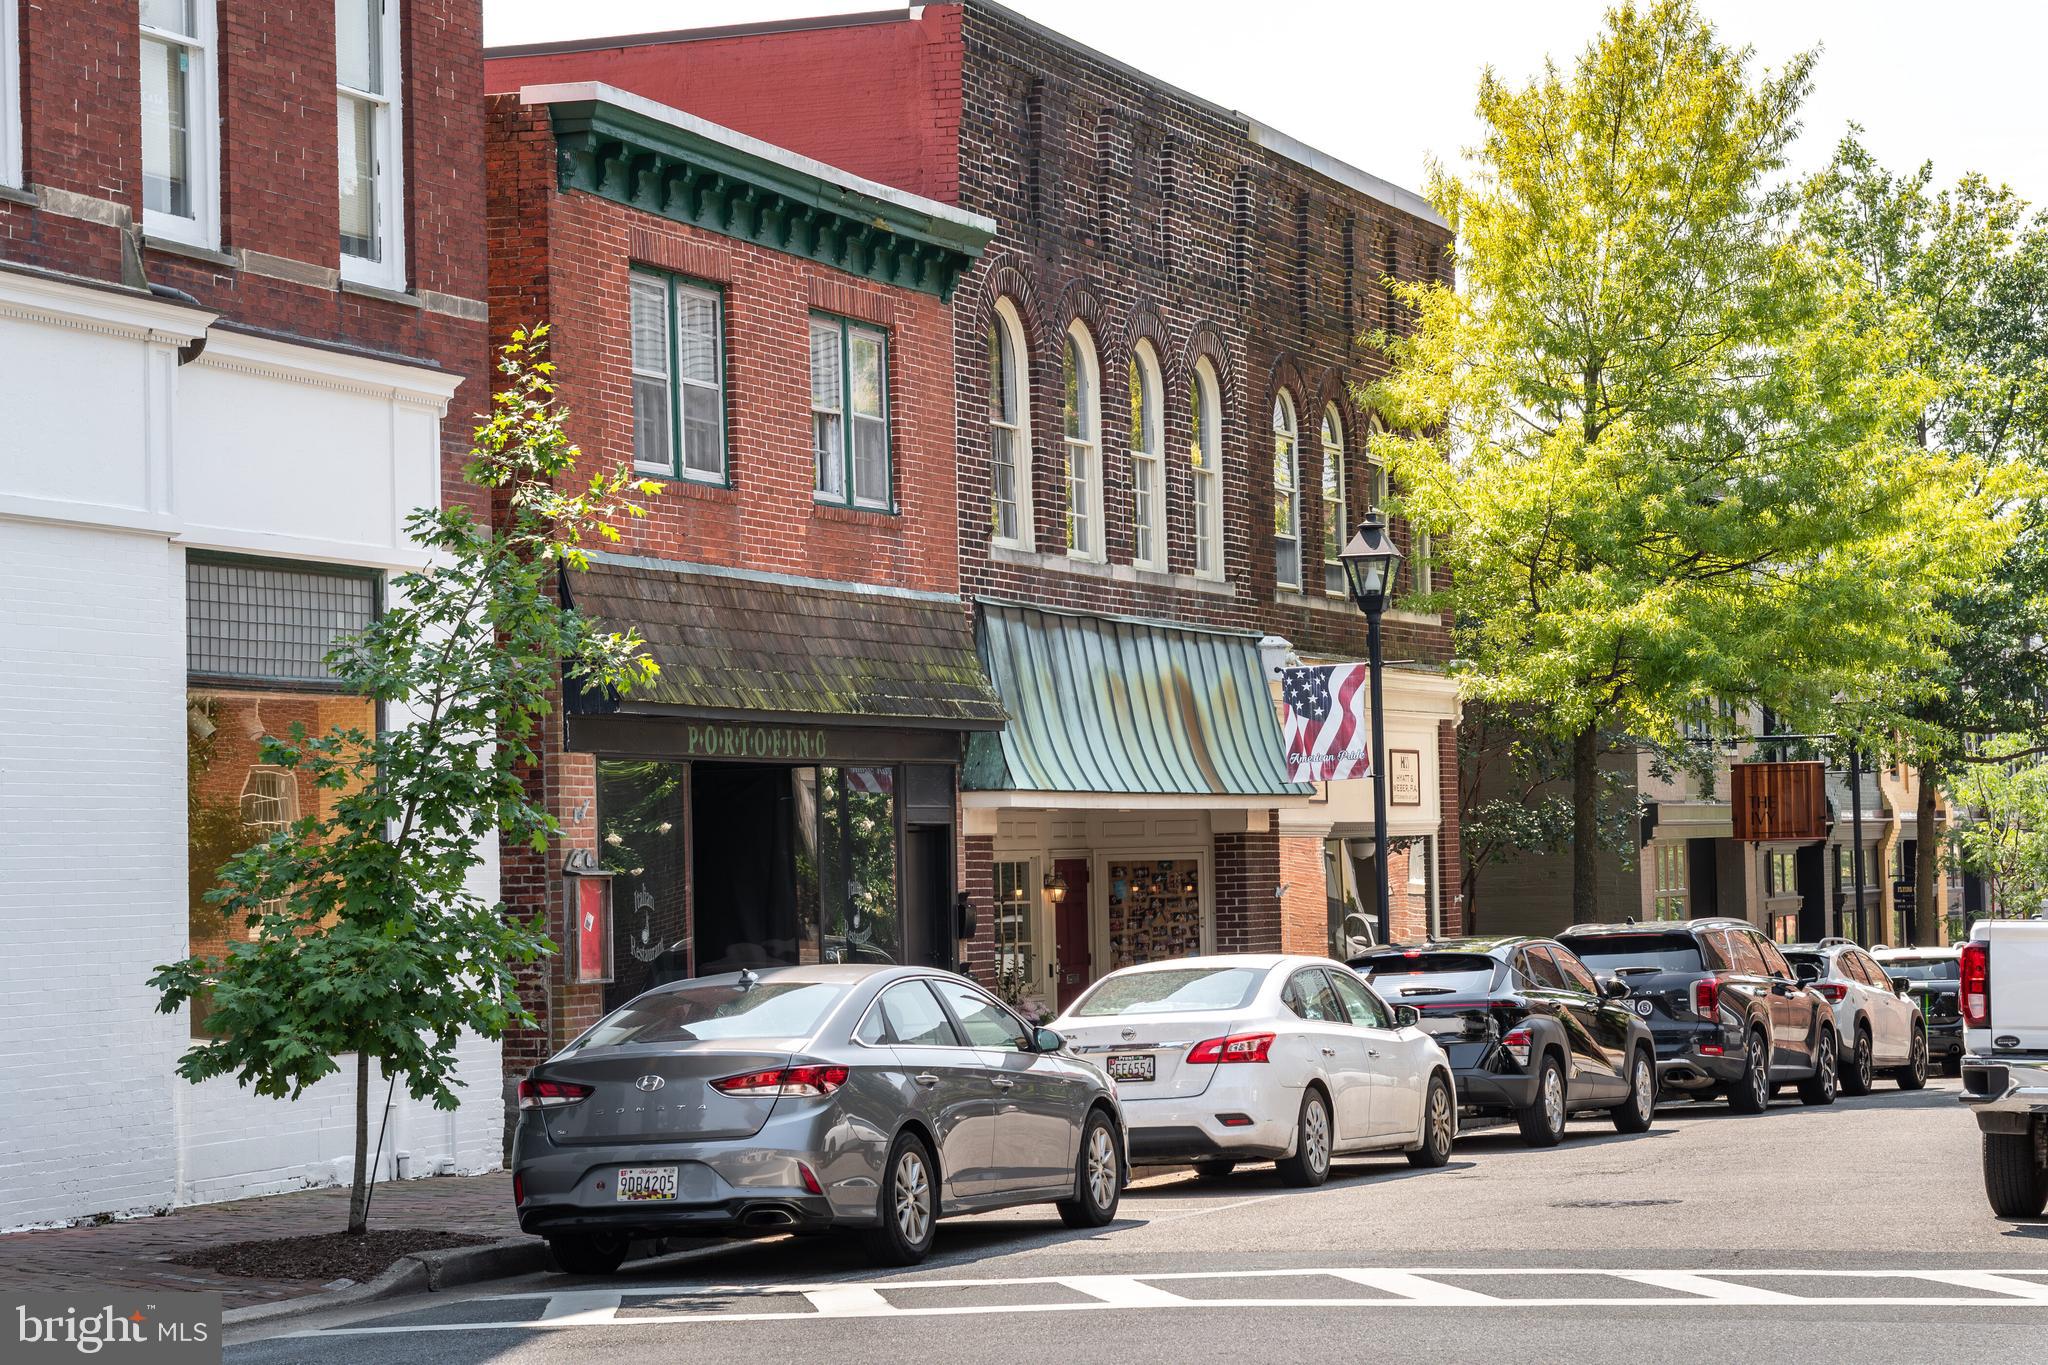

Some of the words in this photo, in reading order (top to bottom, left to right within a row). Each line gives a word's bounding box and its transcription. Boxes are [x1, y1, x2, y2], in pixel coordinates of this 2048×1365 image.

[687, 724, 826, 758] PORTOFINO
[1290, 752, 1335, 765] American
[1338, 749, 1365, 761] Pride
[1749, 795, 1776, 809] THE
[1751, 811, 1776, 825] IVY
[634, 882, 655, 913] Italian
[630, 934, 665, 962] Restaurant
[1109, 1061, 1152, 1077] 5EE6554
